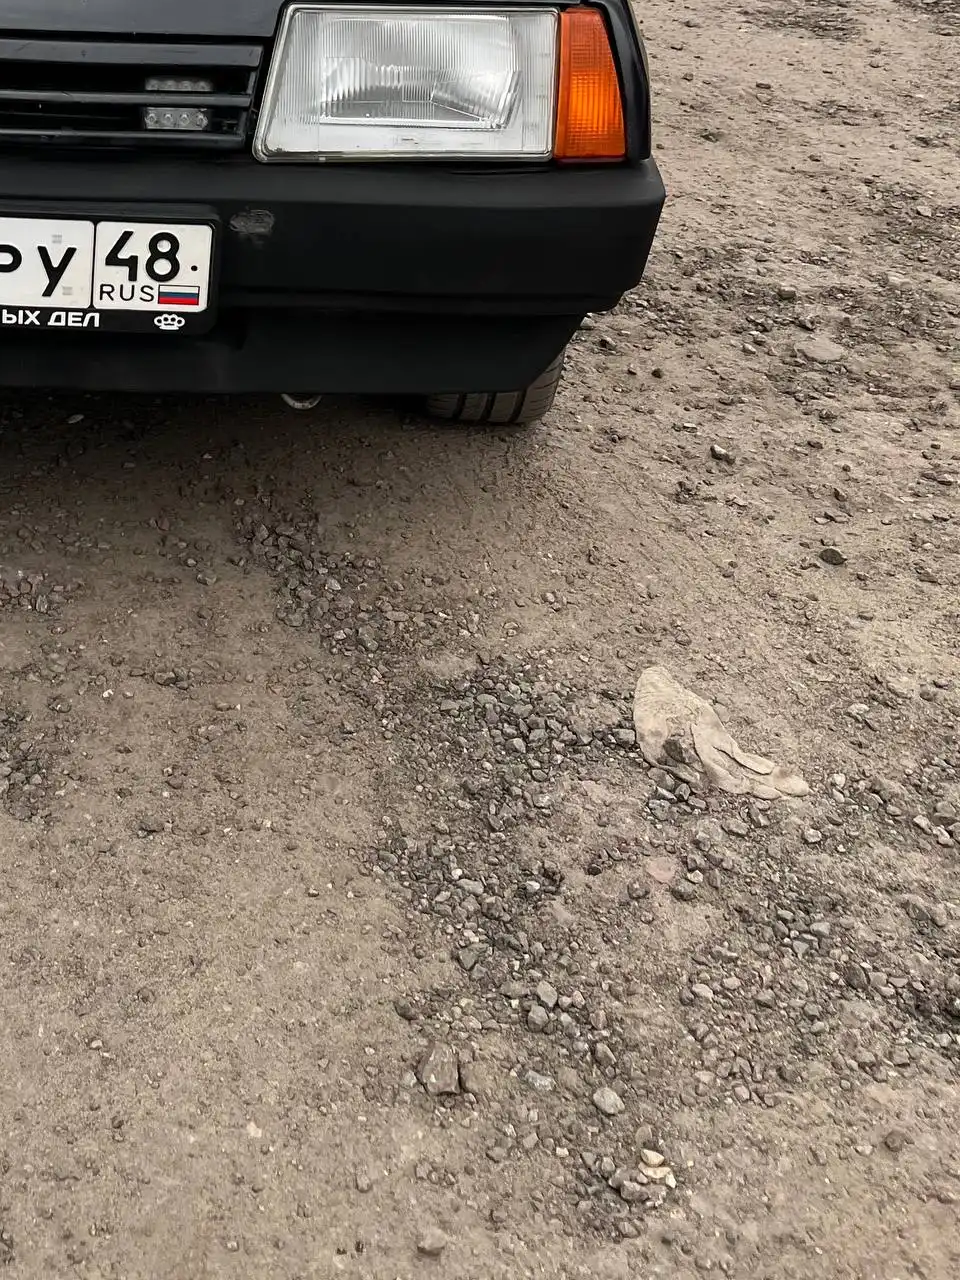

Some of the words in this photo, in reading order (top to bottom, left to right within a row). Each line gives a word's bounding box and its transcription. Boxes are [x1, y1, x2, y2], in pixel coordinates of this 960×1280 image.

[104, 230, 181, 282] 48
[99, 283, 155, 303] RUS
[47, 311, 101, 328] ДЕЛ
